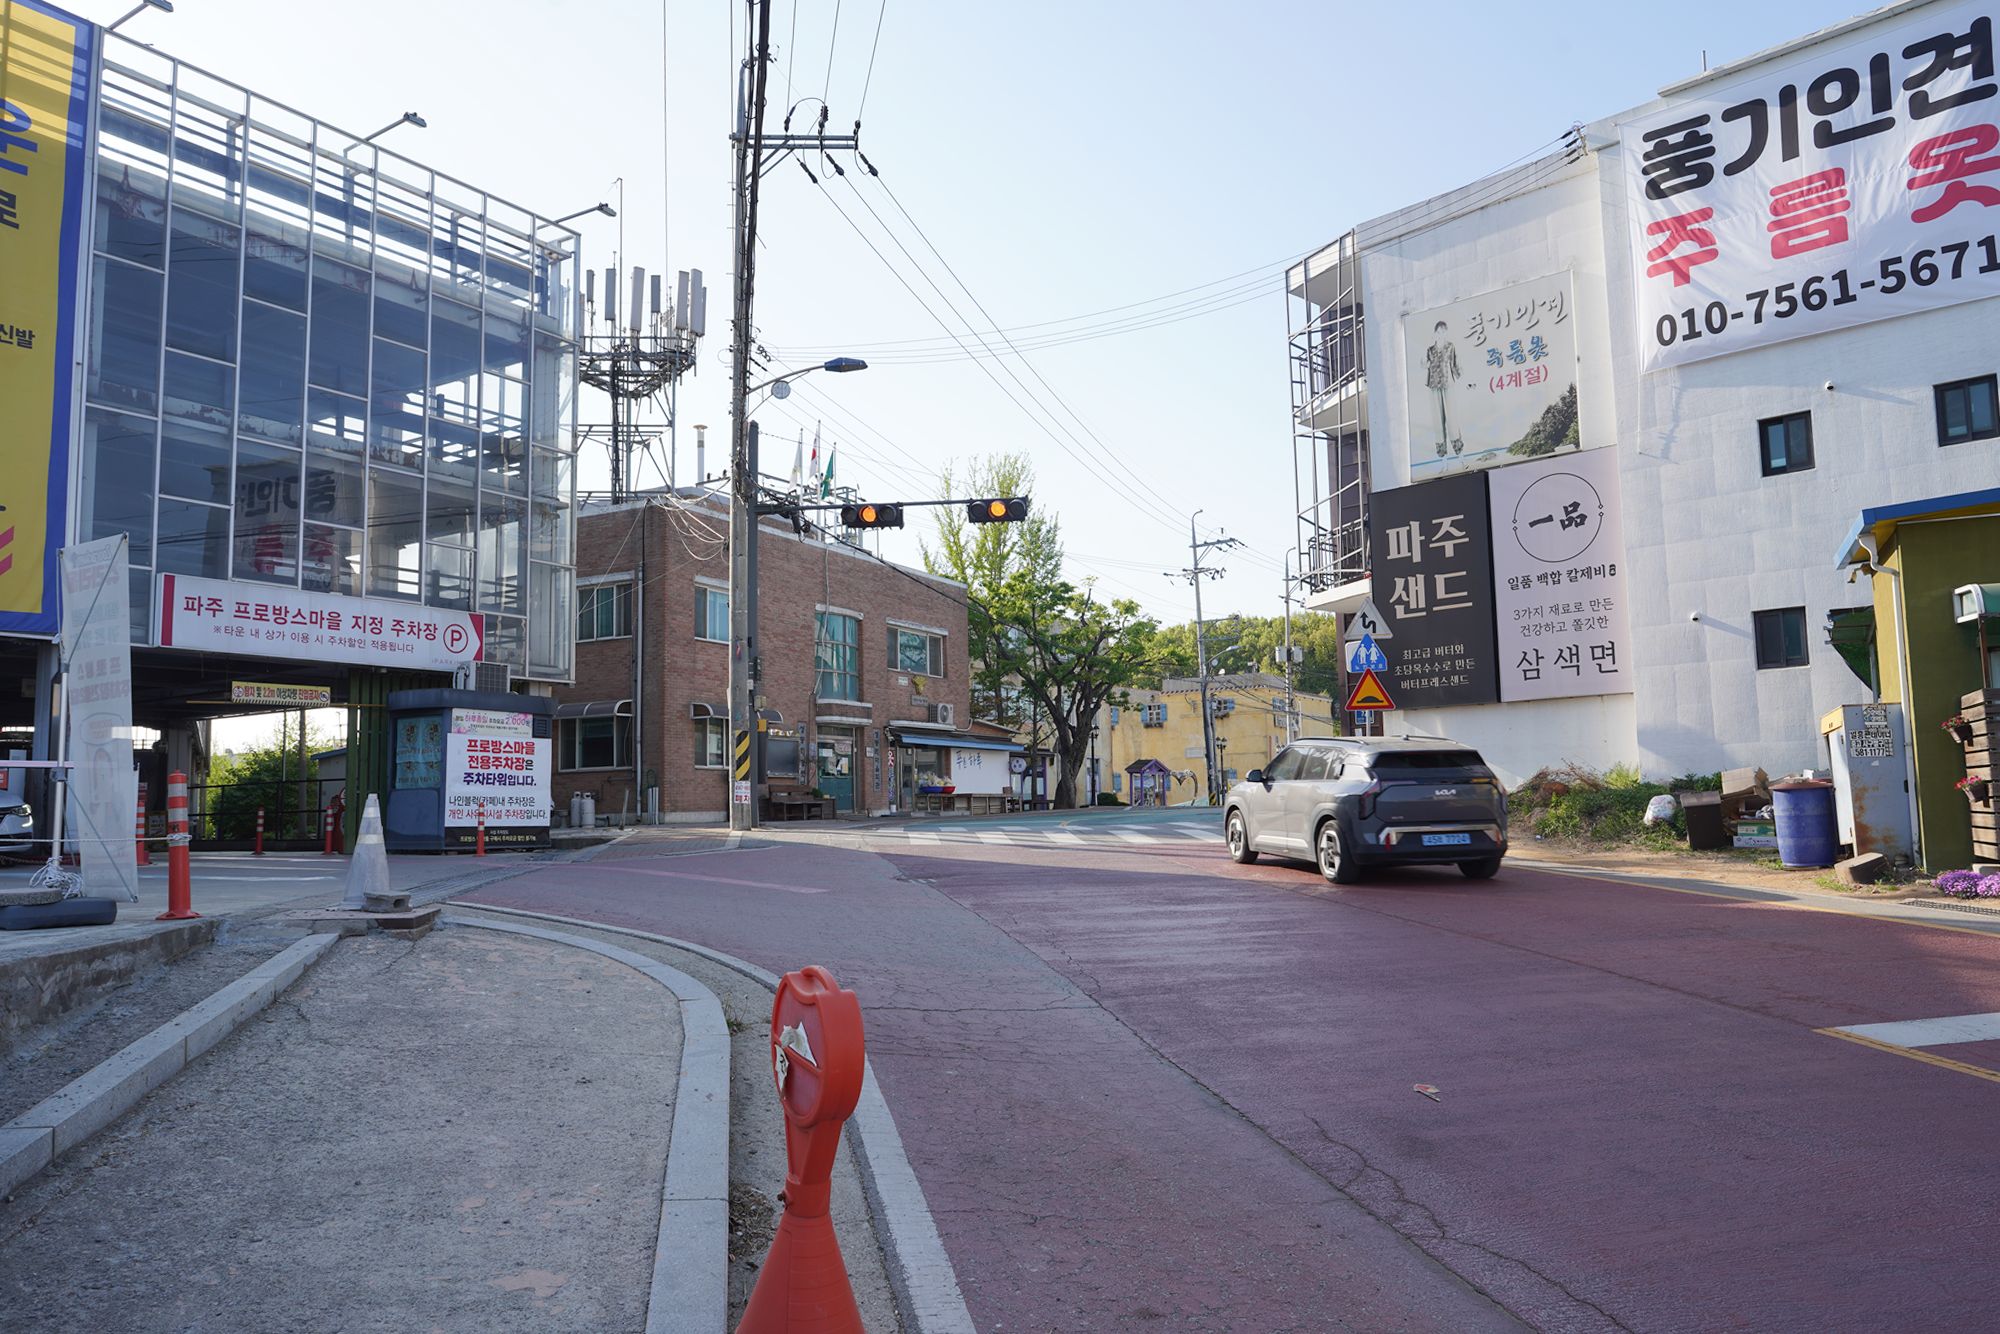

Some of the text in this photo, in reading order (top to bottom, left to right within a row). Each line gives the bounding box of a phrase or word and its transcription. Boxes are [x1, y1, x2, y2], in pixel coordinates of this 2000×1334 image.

[1641, 15, 1998, 200] 풍기인견
[1656, 234, 2000, 347] 010-7561-5671
[1464, 291, 1568, 347] 풍기인견
[1486, 335, 1549, 368] 주름옷
[1489, 364, 1548, 393] (4계절)
[1528, 501, 1587, 531] 一品
[1385, 514, 1470, 563] 파주
[1507, 575, 1533, 591] 일품
[1536, 570, 1562, 586] 백합
[1566, 564, 1606, 583] 칼제비
[1389, 570, 1473, 619] 샌드
[183, 595, 224, 618] 파주
[233, 601, 342, 631] 프로방스마을
[351, 614, 384, 636] 지정
[390, 618, 438, 641] 주차장
[1513, 597, 1614, 621] 3가지 재료로 만든
[1520, 615, 1609, 637] 건강하고 쫄깃한
[250, 627, 260, 640] 내
[264, 629, 286, 642] 상가
[290, 631, 310, 644] 이용
[314, 633, 324, 645] 시
[327, 635, 366, 649] 주차할인
[370, 639, 414, 654] 적용됩니다
[1402, 644, 1464, 660] 최고급 버터와
[1394, 658, 1476, 676] 초당옥수수로 만든
[1516, 640, 1619, 681] 삼색면
[1401, 674, 1470, 690] 버터프레스샌드
[467, 739, 535, 755] 프로방스마을
[468, 755, 534, 771] 전용주차장은
[463, 772, 536, 786] 주차타워입니다.
[448, 809, 464, 819] 개인
[507, 797, 535, 807] 주차장은
